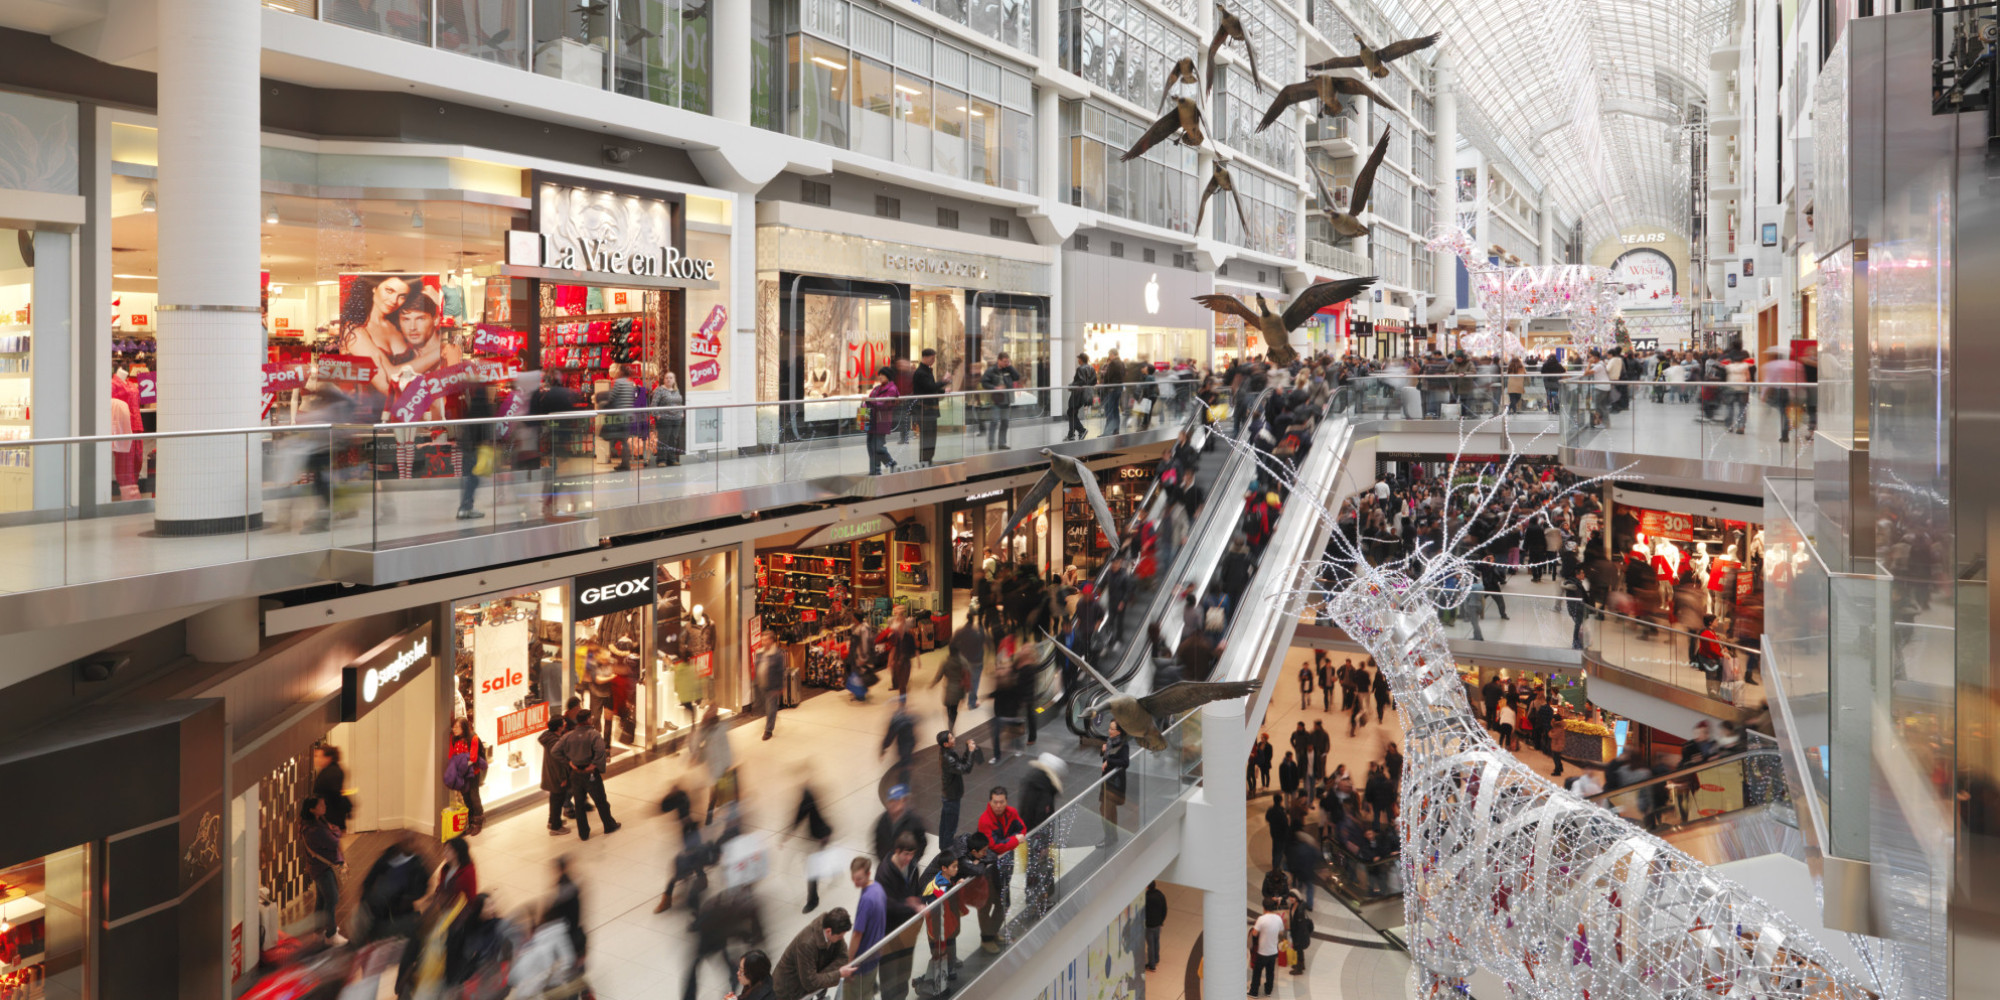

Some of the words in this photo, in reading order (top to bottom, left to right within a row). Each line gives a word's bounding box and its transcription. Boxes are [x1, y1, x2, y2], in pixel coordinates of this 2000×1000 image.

[1621, 232, 1666, 244] SEARS
[541, 234, 576, 269] La
[579, 237, 625, 274] Vie
[630, 252, 657, 276] en
[662, 247, 715, 280] Rose
[475, 329, 515, 351] 2FOR1
[691, 342, 718, 355] SALE
[318, 366, 371, 381] SALE
[478, 366, 518, 383] SALE
[831, 519, 882, 539] COLLACUTT
[580, 576, 650, 604] GEOX
[482, 668, 523, 694] sale
[502, 710, 526, 735] TODAY
[527, 704, 545, 727] ONLY
